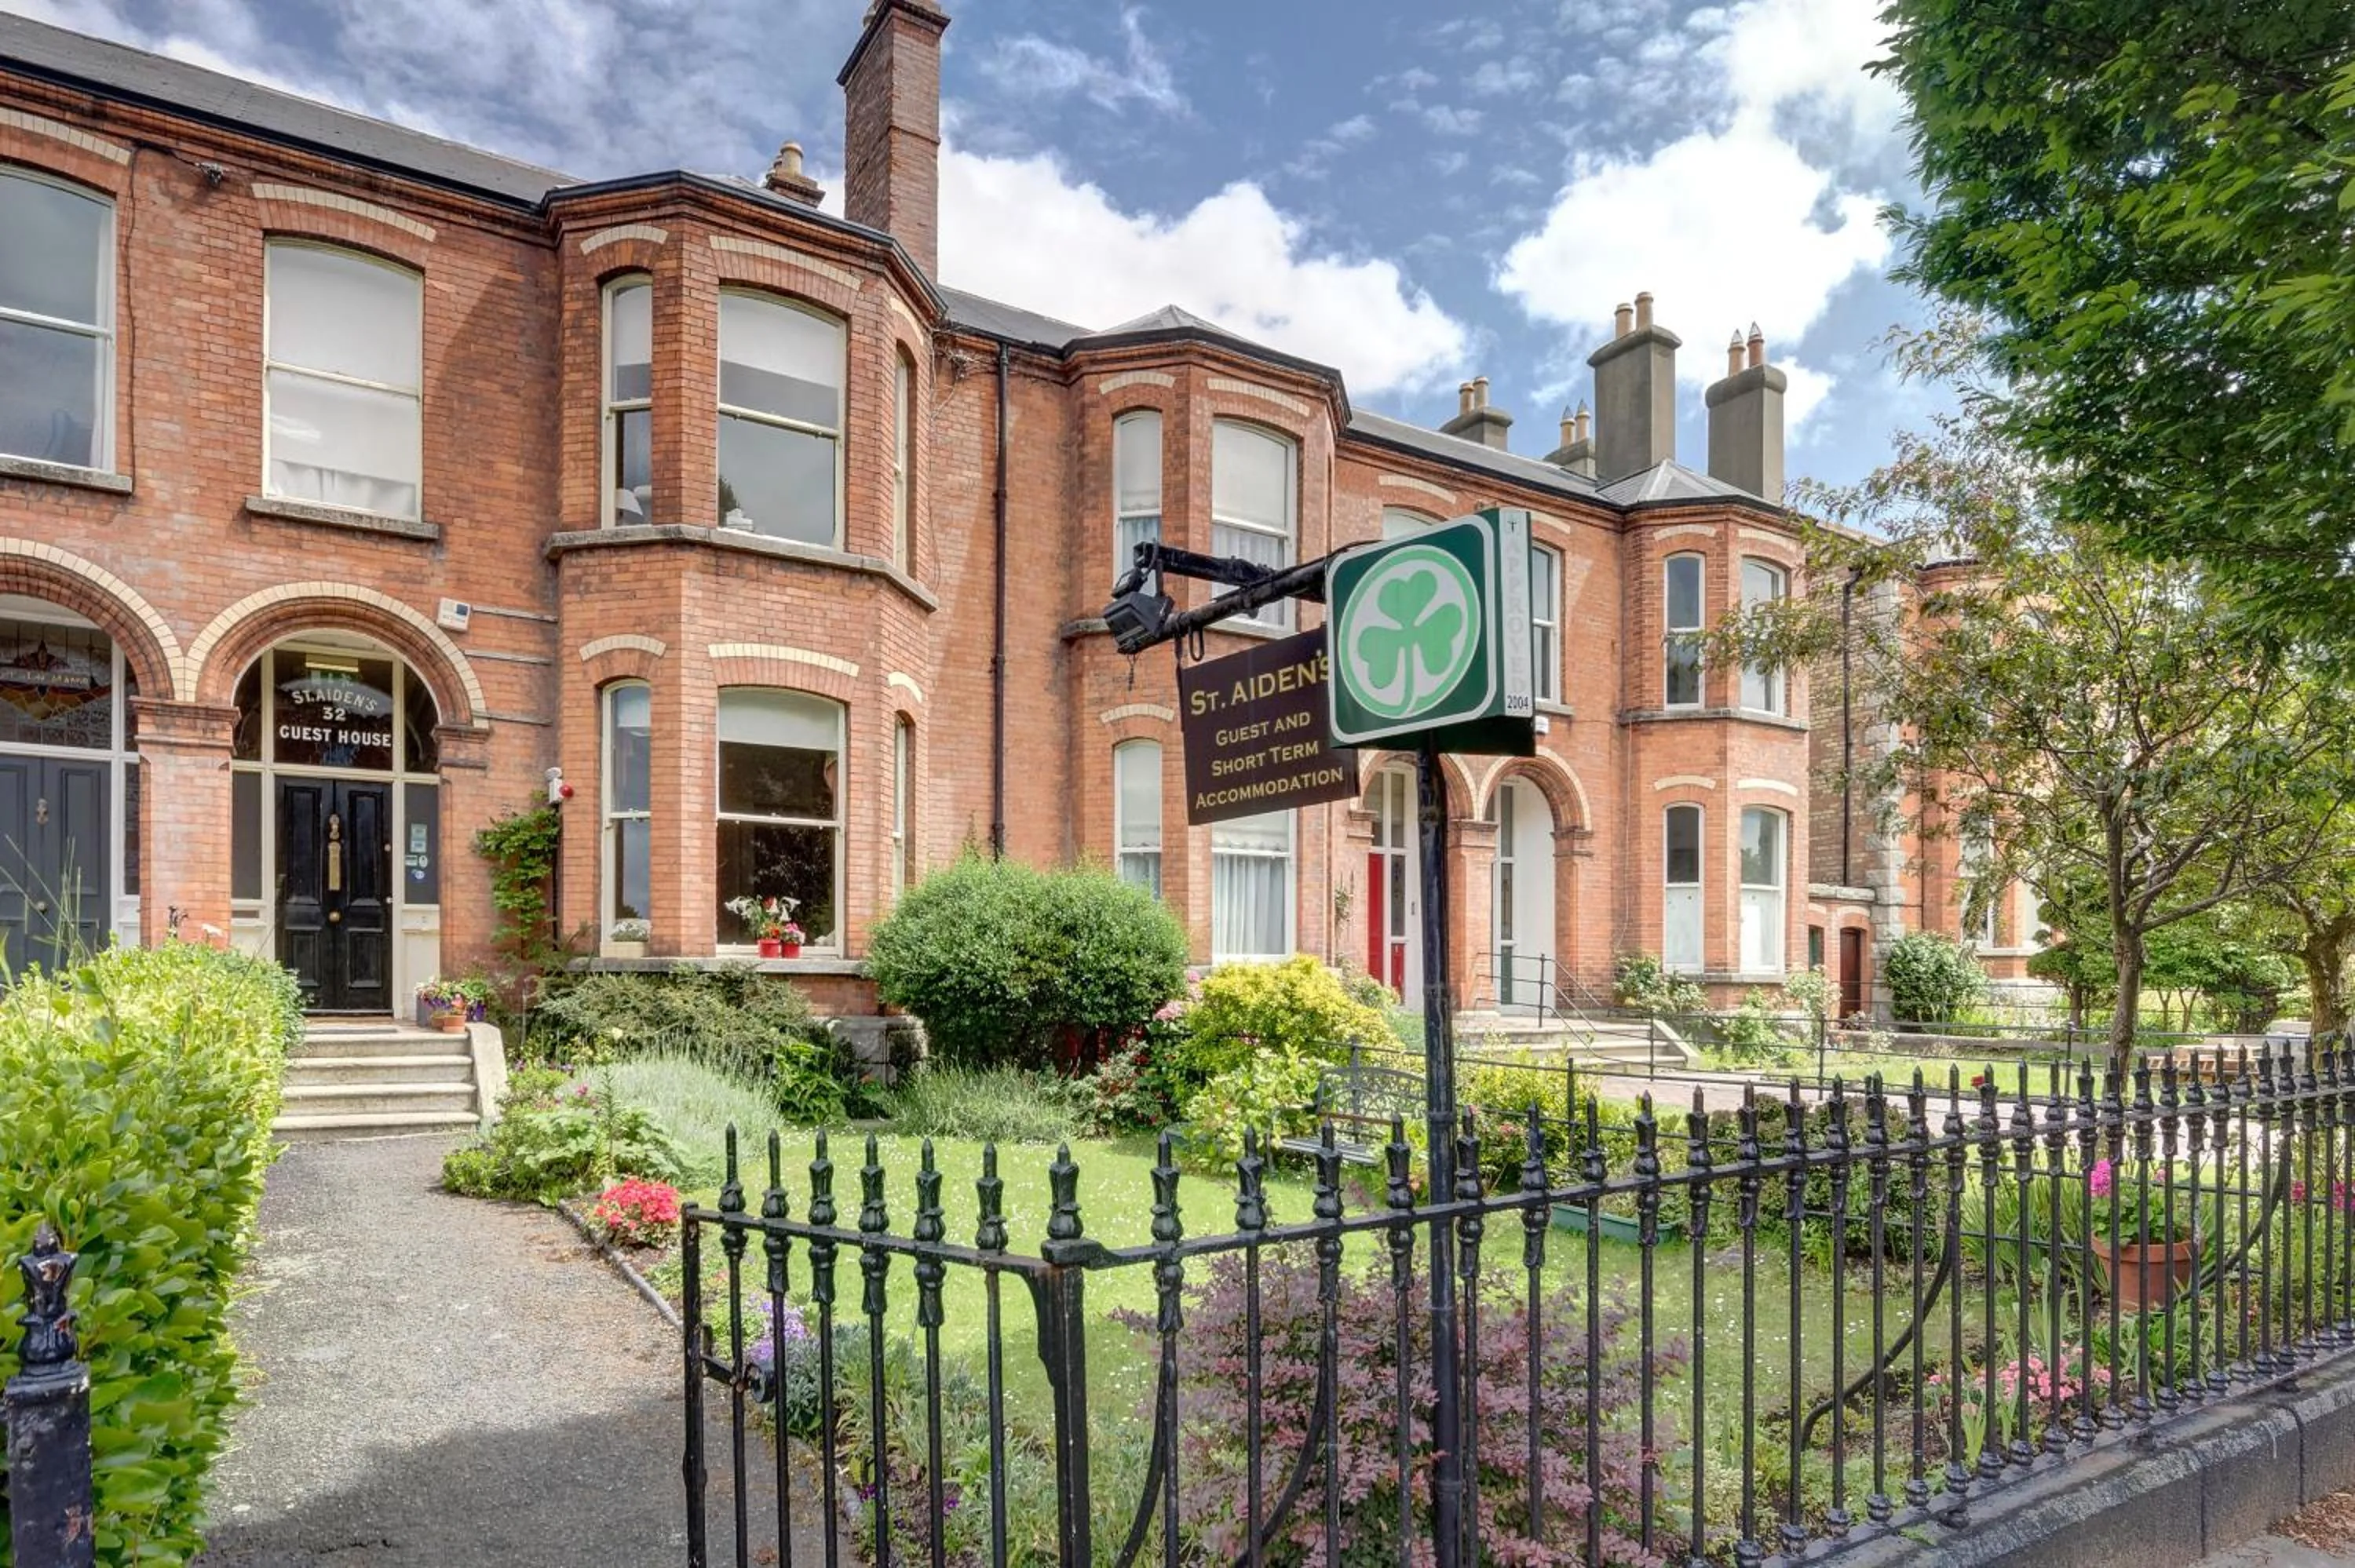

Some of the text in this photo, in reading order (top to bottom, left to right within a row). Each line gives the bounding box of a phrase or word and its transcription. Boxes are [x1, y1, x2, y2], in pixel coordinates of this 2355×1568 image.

[1231, 649, 1329, 706] AIDEN'S
[323, 707, 346, 721] 32
[1507, 695, 1529, 710] 2004
[279, 725, 392, 746] GUEST HOUSE
[1216, 711, 1311, 746] GUEST AND
[1211, 740, 1319, 776] SHORT TERM
[1195, 766, 1345, 809] ACCOMMODATION
